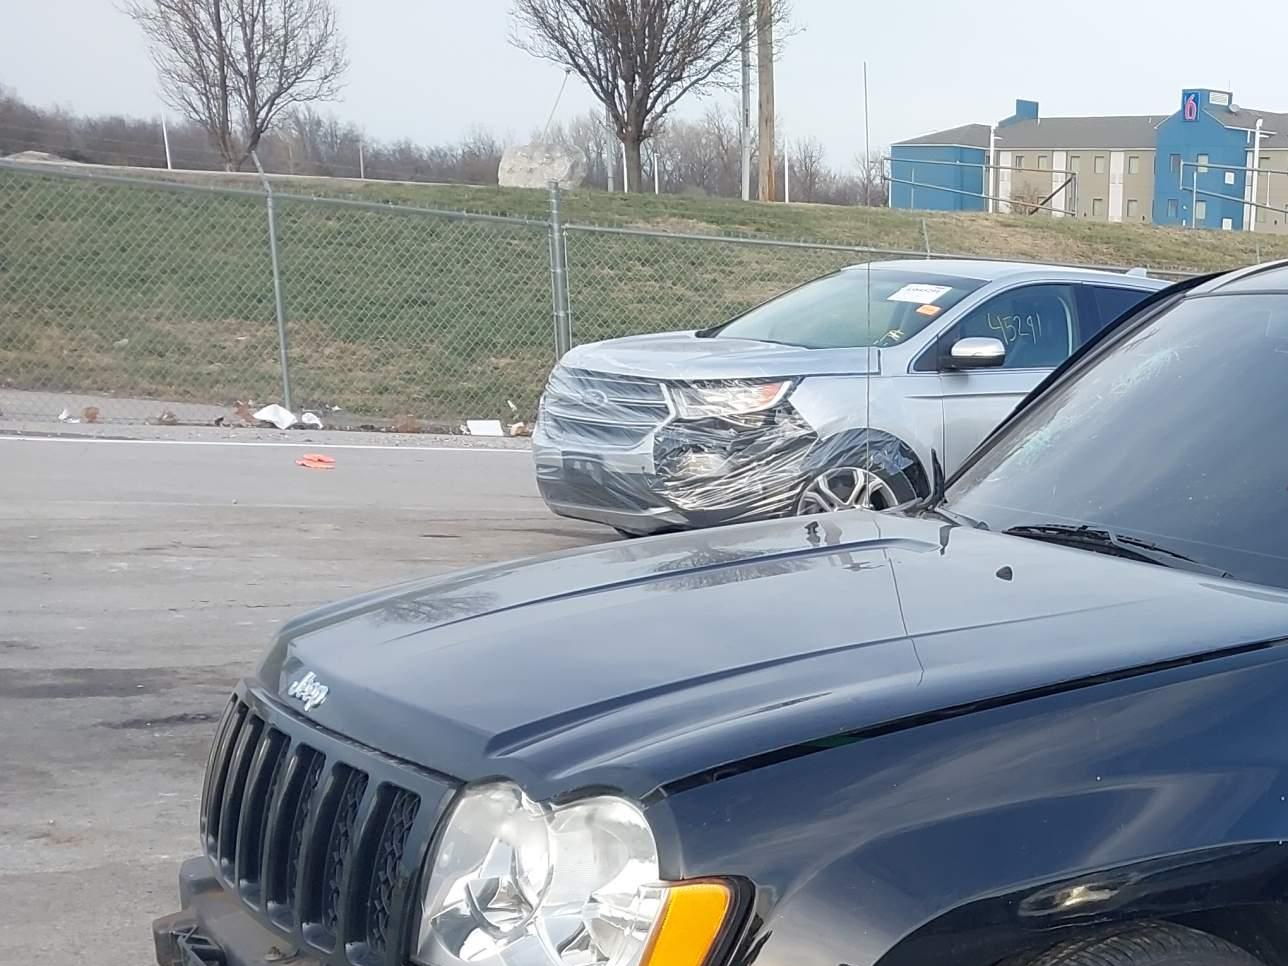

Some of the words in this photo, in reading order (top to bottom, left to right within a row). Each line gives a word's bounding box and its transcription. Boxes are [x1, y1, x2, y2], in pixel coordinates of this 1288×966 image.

[1184, 93, 1197, 121] 6
[986, 312, 1042, 345] 45291
[287, 671, 329, 711] Jeep
